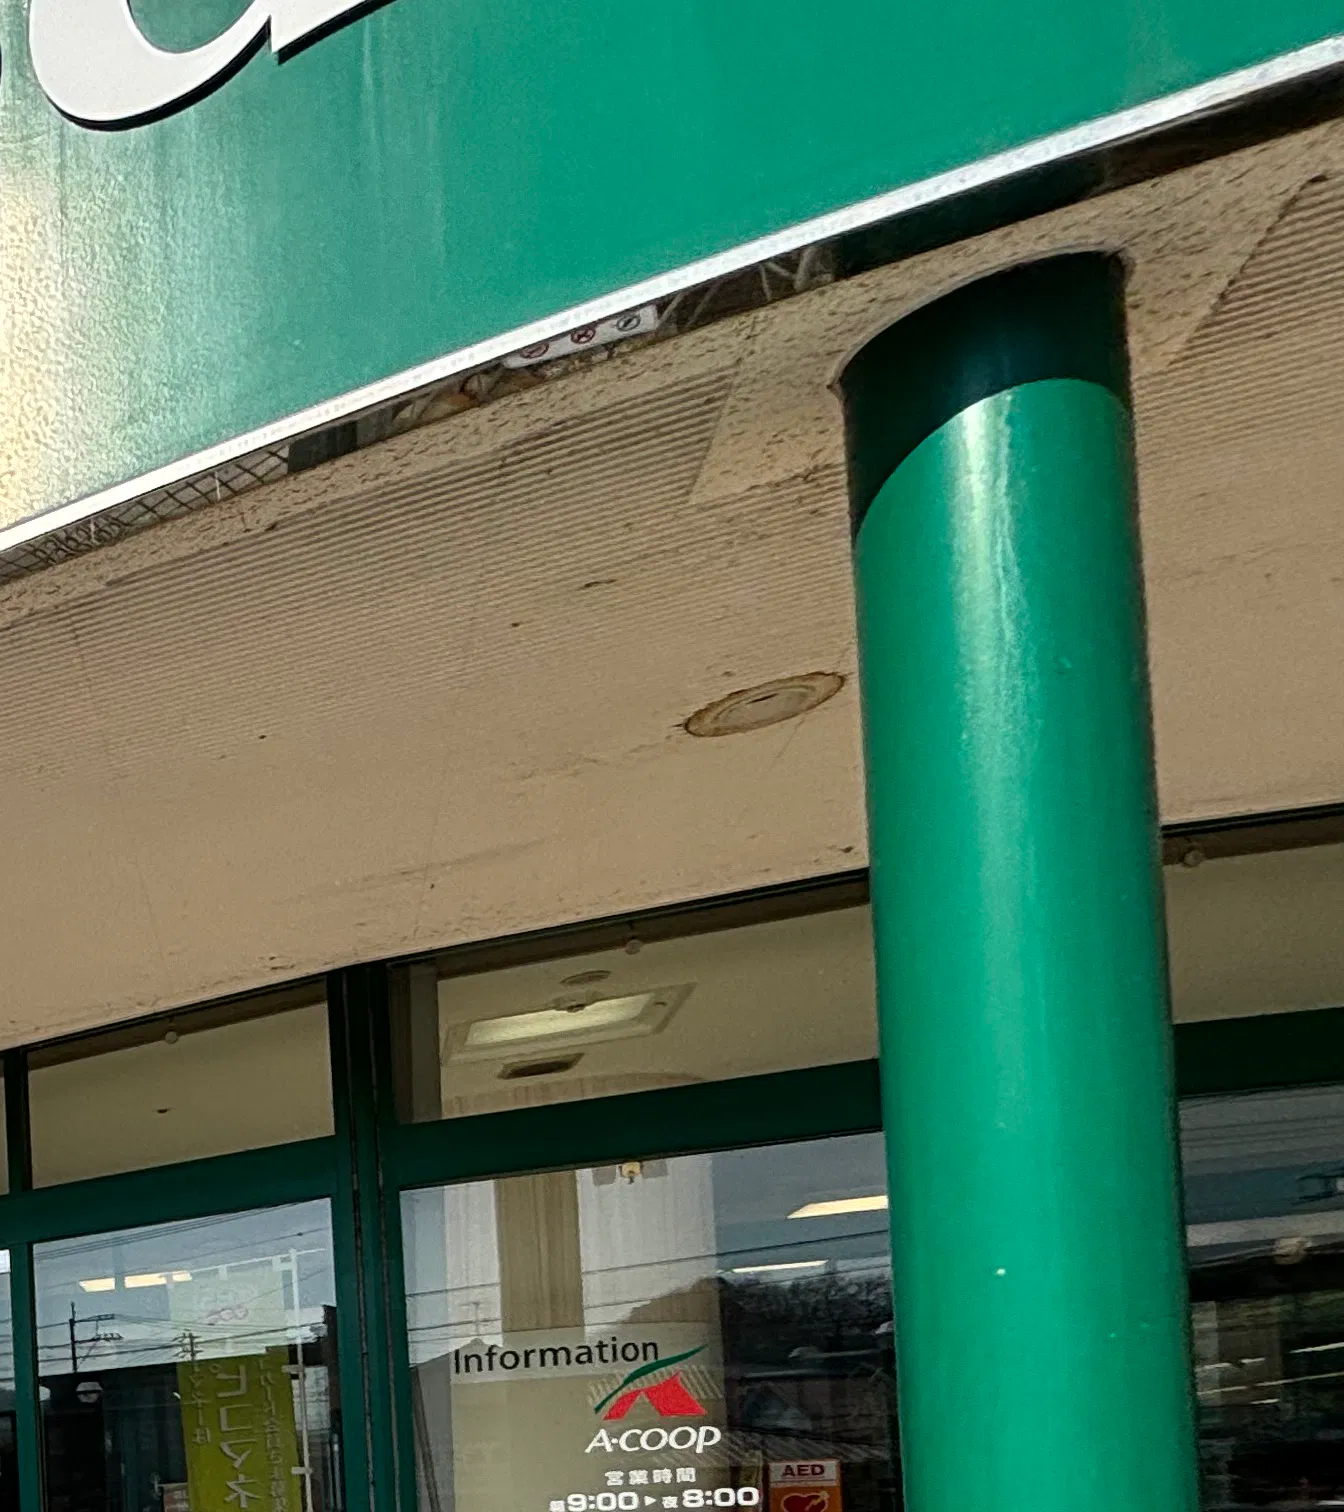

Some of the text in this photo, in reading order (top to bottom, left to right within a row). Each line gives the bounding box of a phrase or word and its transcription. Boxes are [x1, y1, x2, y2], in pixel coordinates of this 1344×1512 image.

[453, 1335, 659, 1375] Information
[604, 1467, 697, 1487] 営業時間
[781, 1463, 825, 1477] AED
